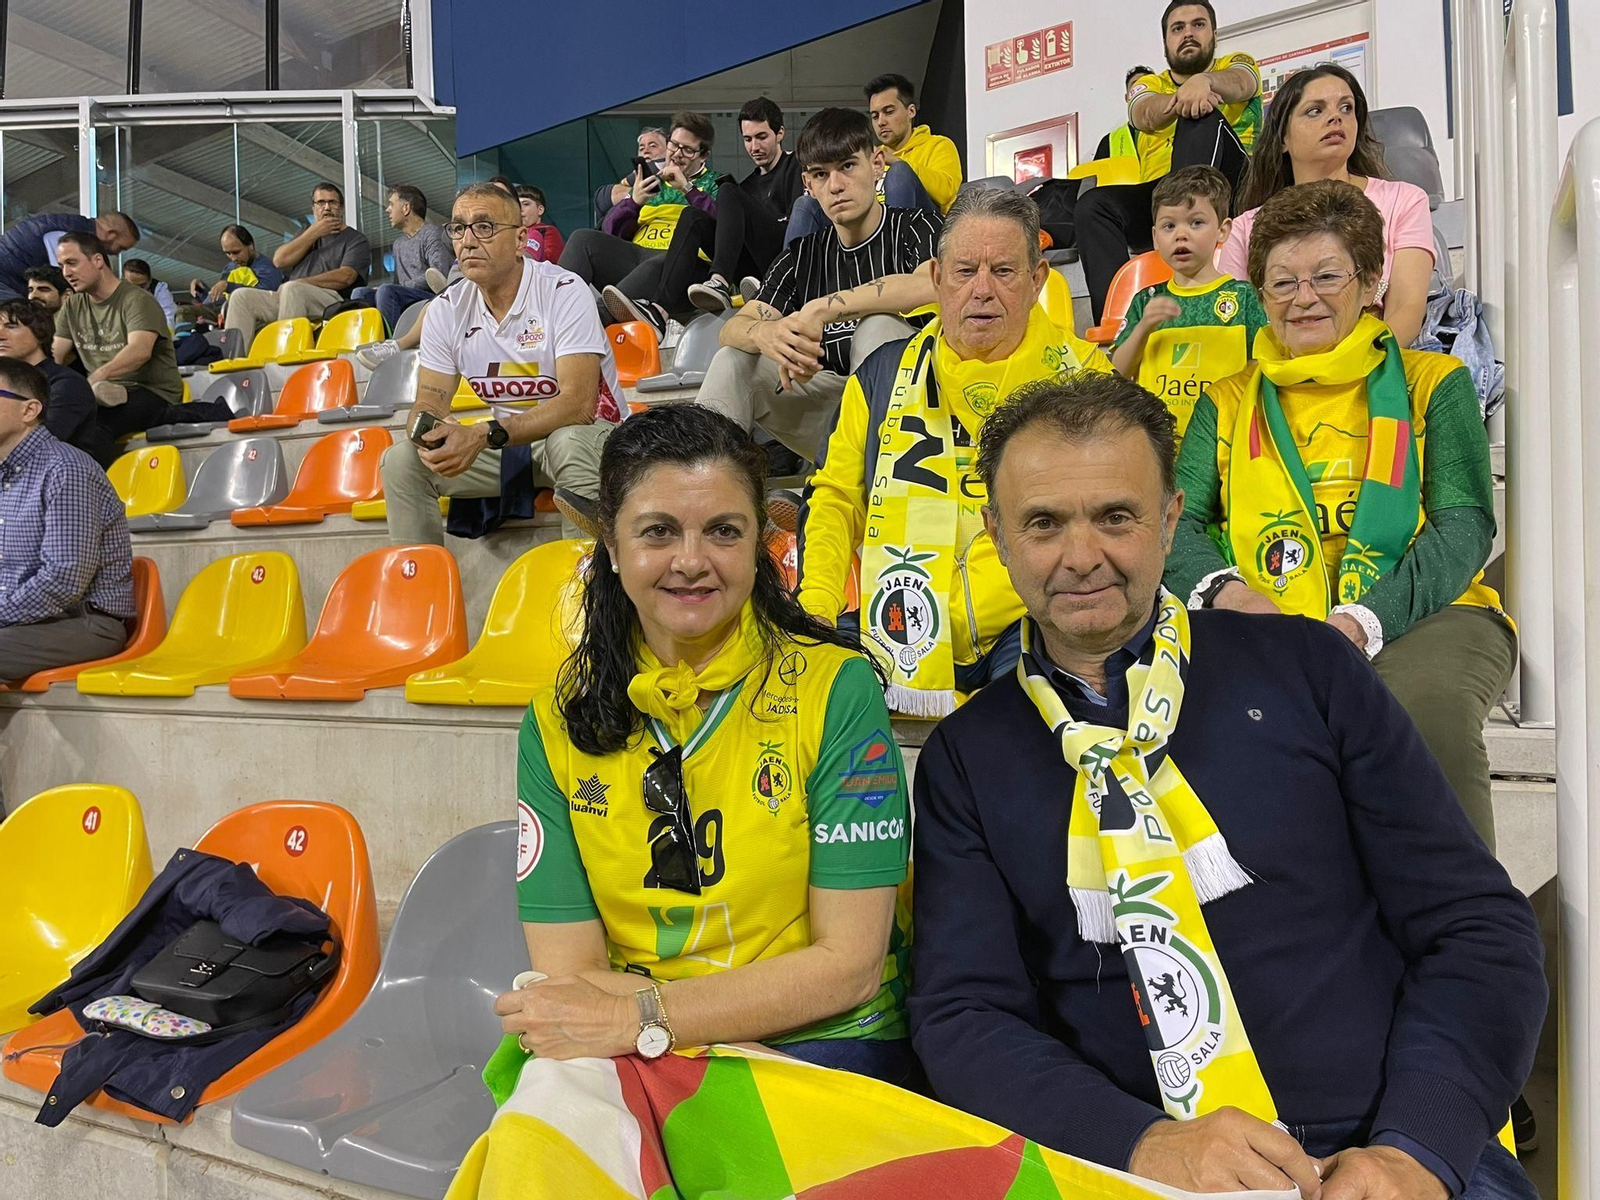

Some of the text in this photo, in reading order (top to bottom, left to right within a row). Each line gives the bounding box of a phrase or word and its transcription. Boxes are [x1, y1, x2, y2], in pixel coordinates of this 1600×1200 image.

[1045, 58, 1071, 69] EXTINTOR
[616, 334, 624, 343] 47
[1264, 529, 1299, 544] JAEN
[252, 568, 264, 582] 42
[402, 560, 416, 576] 43
[1342, 562, 1376, 578] JAEN
[885, 577, 923, 591] JAEN
[916, 641, 935, 658] SALA
[759, 756, 783, 769] JAEN
[571, 800, 609, 818] luanvi
[85, 811, 98, 830] 41
[287, 830, 306, 851] 42
[1191, 1030, 1222, 1065] SALA
